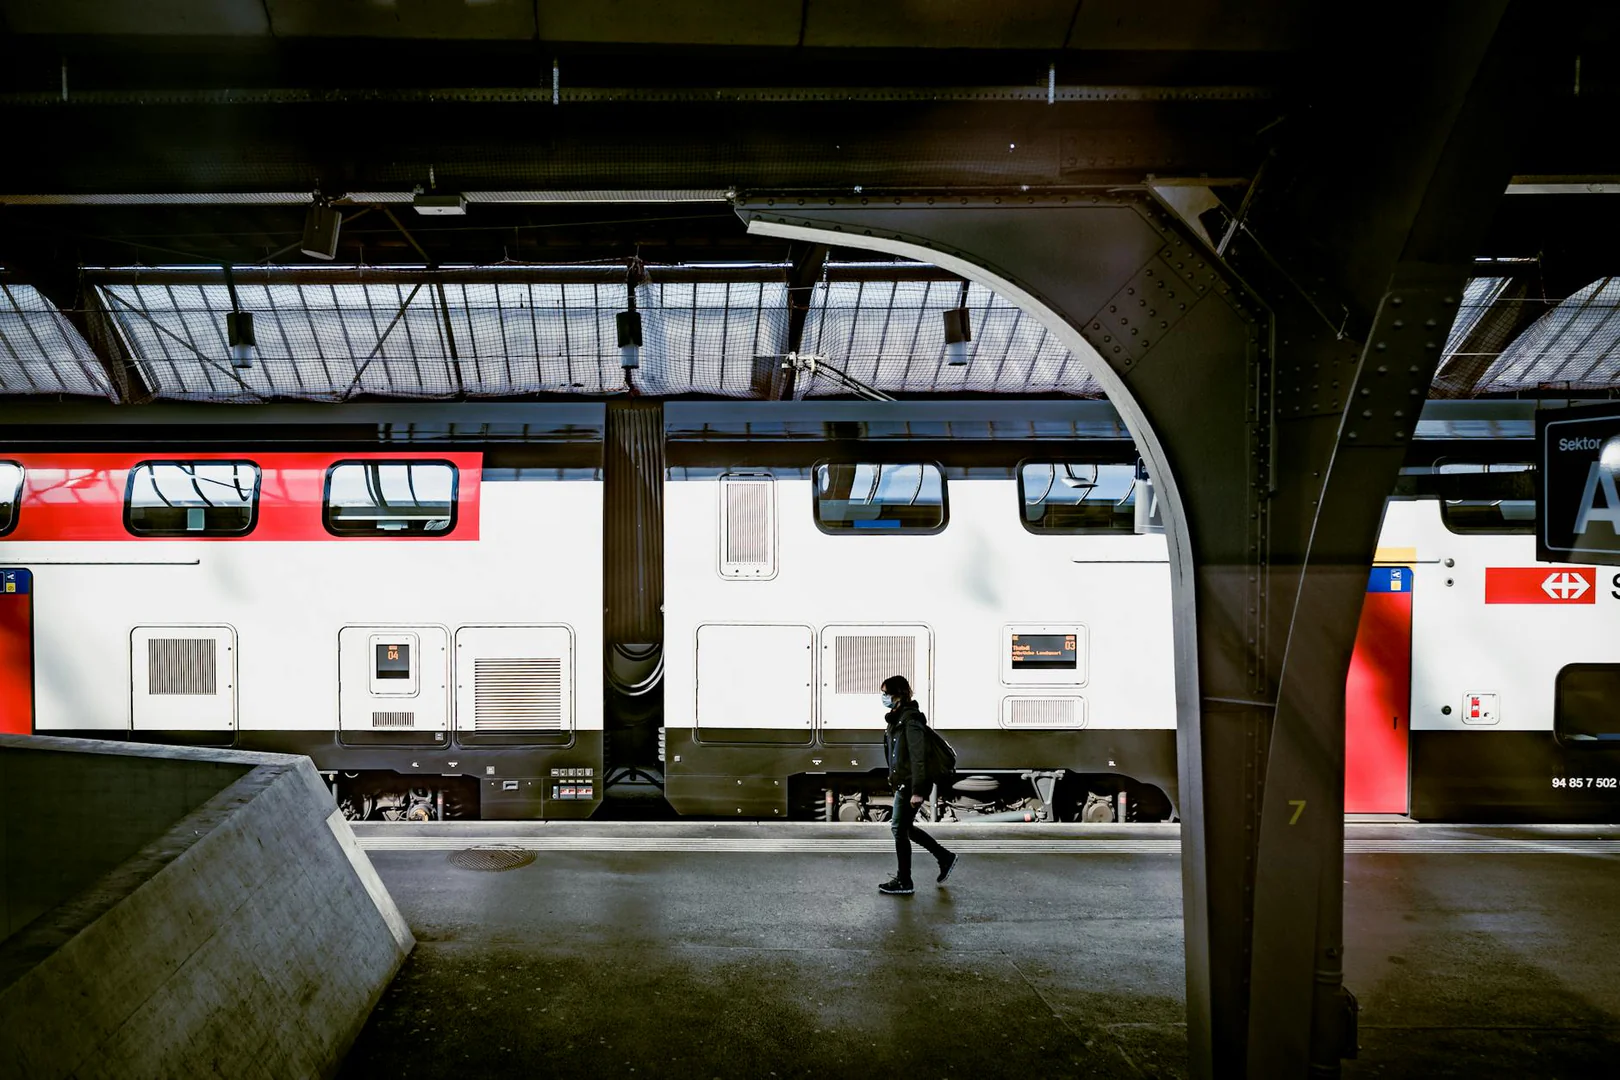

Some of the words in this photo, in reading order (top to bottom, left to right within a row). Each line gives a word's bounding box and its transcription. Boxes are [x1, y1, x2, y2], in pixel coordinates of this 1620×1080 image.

[1558, 437, 1602, 451] Sektor
[1573, 461, 1620, 535] A
[1065, 641, 1076, 650] 03
[388, 650, 398, 660] 04
[1551, 777, 1567, 788] 94
[1568, 777, 1584, 788] 85
[1585, 777, 1594, 788] 7
[1595, 777, 1617, 788] 502
[1288, 800, 1306, 824] 7
